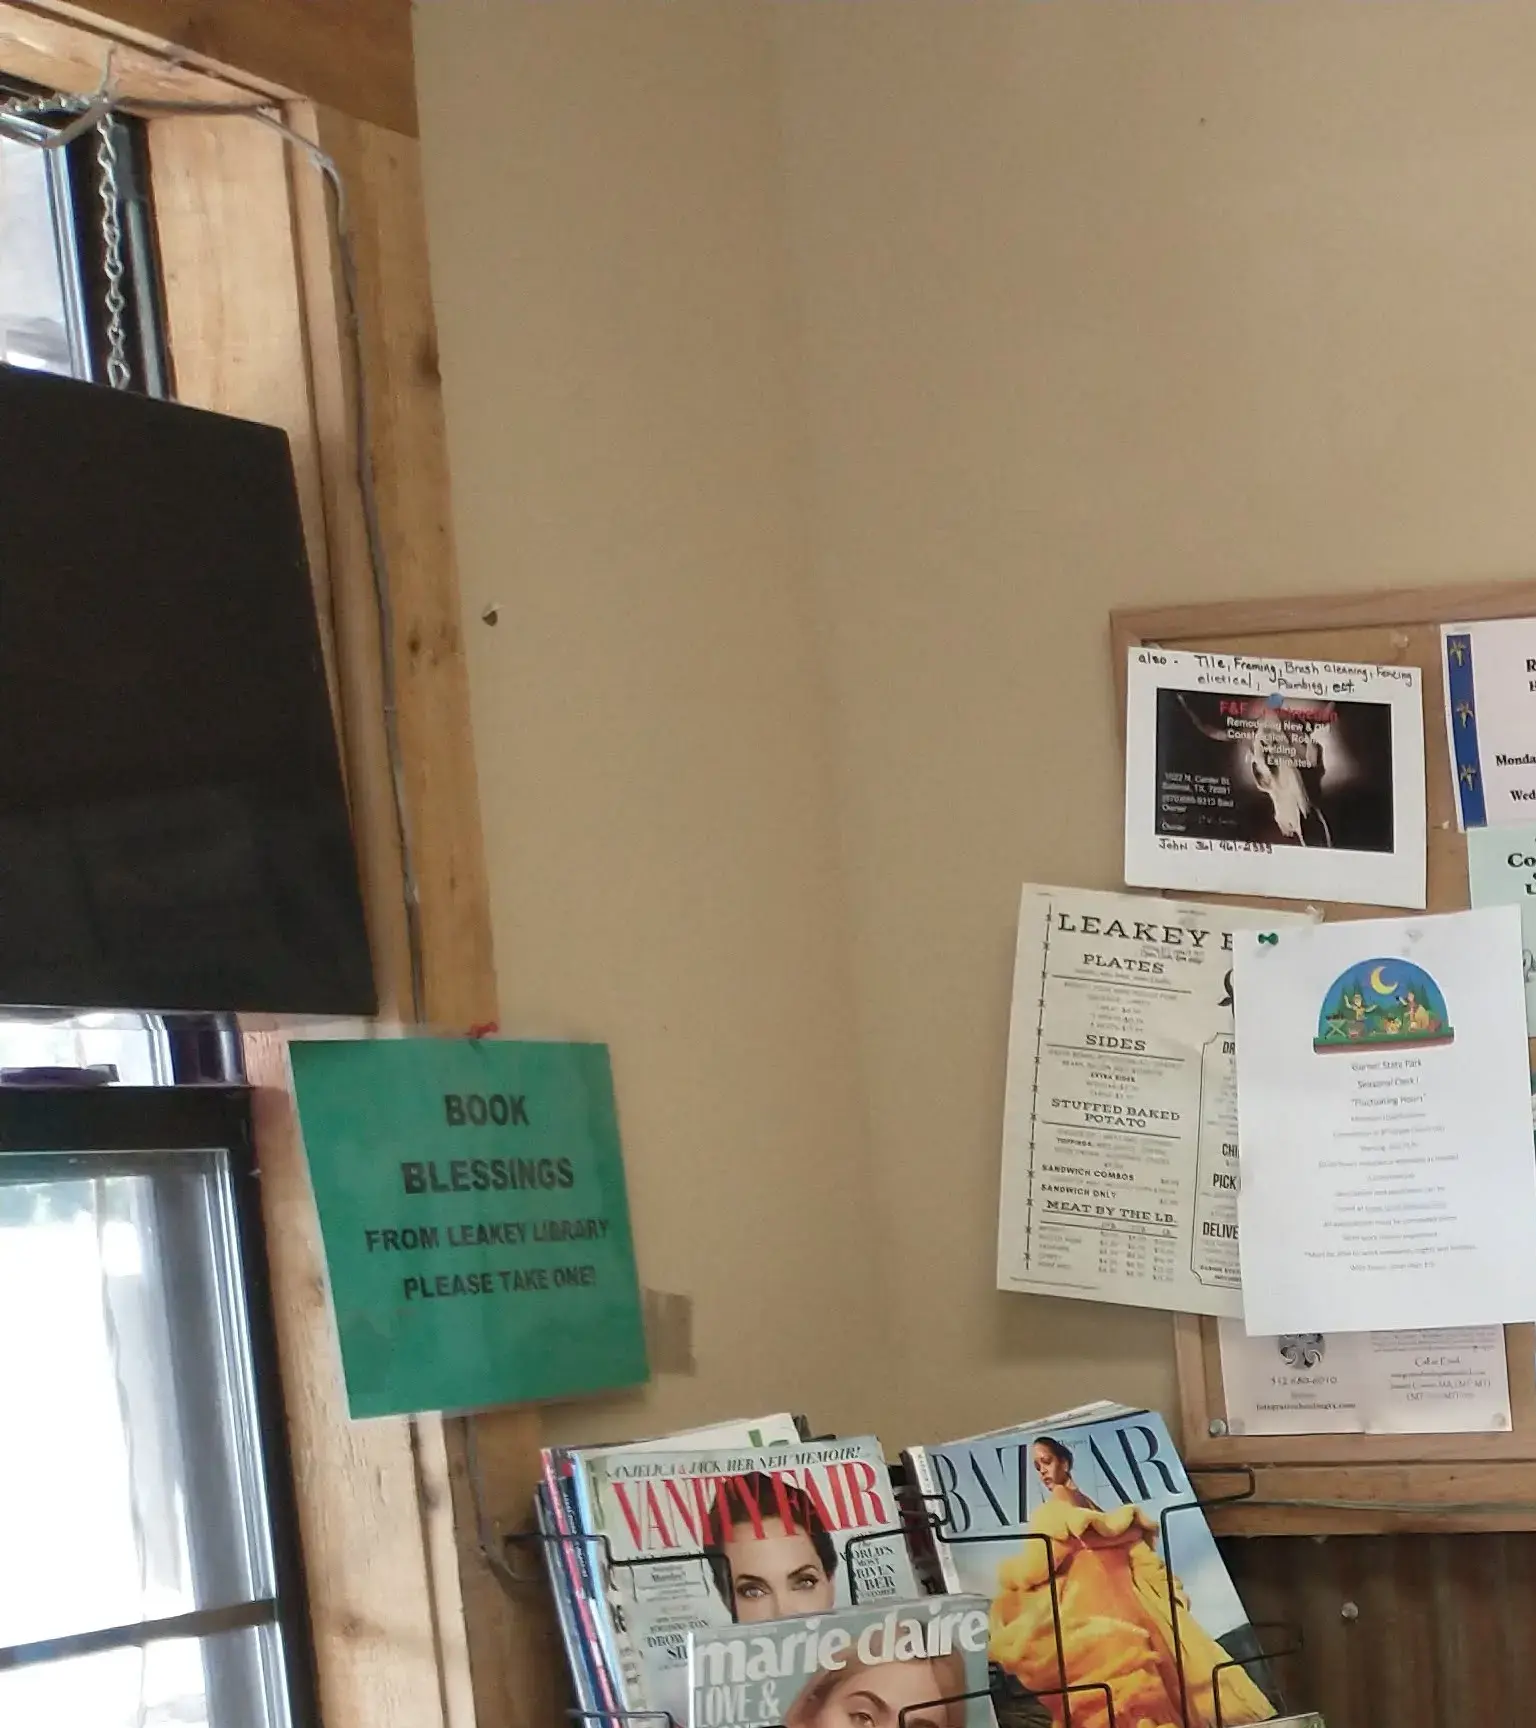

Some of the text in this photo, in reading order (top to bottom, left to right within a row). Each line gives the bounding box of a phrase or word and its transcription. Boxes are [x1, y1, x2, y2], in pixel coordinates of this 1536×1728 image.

[1058, 912, 1210, 950] LEAKEY
[1083, 953, 1165, 976] PLATES
[1086, 1034, 1147, 1052] SIDES
[445, 1094, 530, 1127] BOOK
[1051, 1098, 1180, 1122] STUFFED BAKED
[1084, 1114, 1147, 1129] POTATO
[402, 1157, 574, 1194] BLESSINGS
[365, 1218, 609, 1253] FROM LEAKEY LIBRARY
[404, 1269, 550, 1300] PLEASE TAKE
[612, 1459, 891, 1551] VANITY FAIR
[694, 1604, 989, 1688] marie claire
